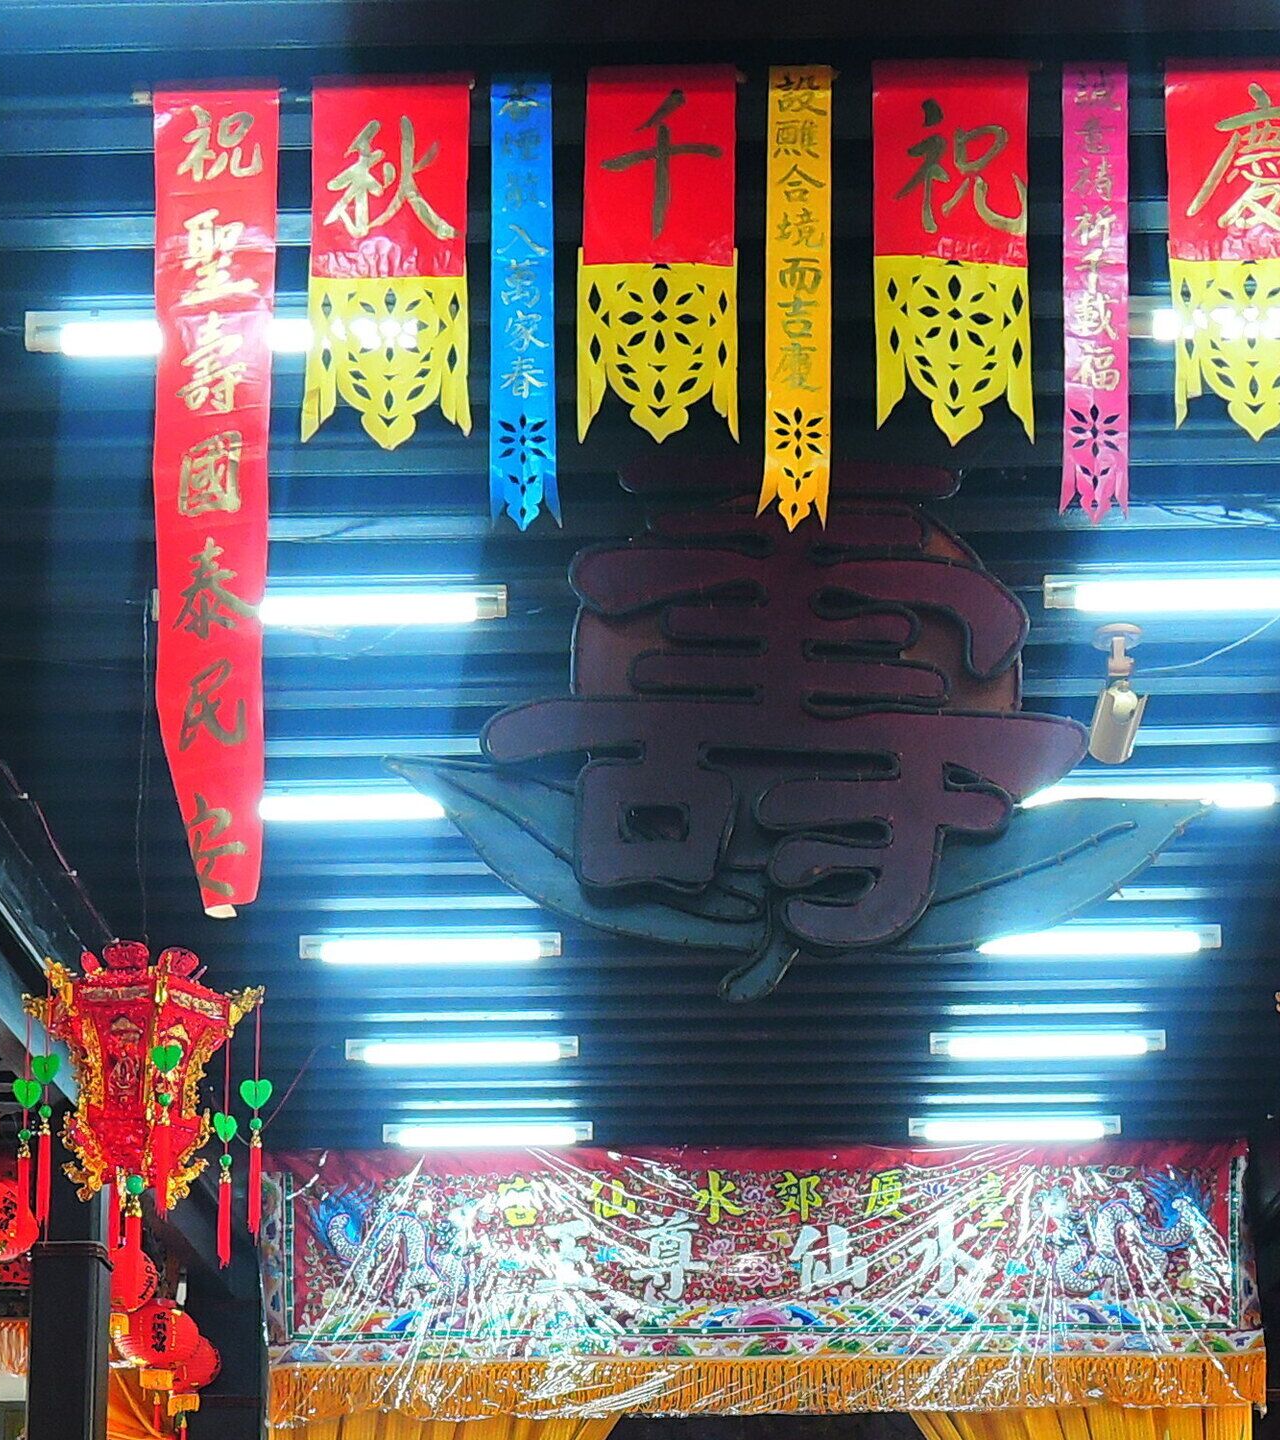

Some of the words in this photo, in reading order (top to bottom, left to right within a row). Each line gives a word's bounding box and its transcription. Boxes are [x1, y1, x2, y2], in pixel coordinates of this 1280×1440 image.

[326, 114, 461, 240] 秋
[601, 89, 723, 240] 千
[895, 98, 1027, 235] 祝
[173, 103, 263, 899] 祝聖壽國泰民安
